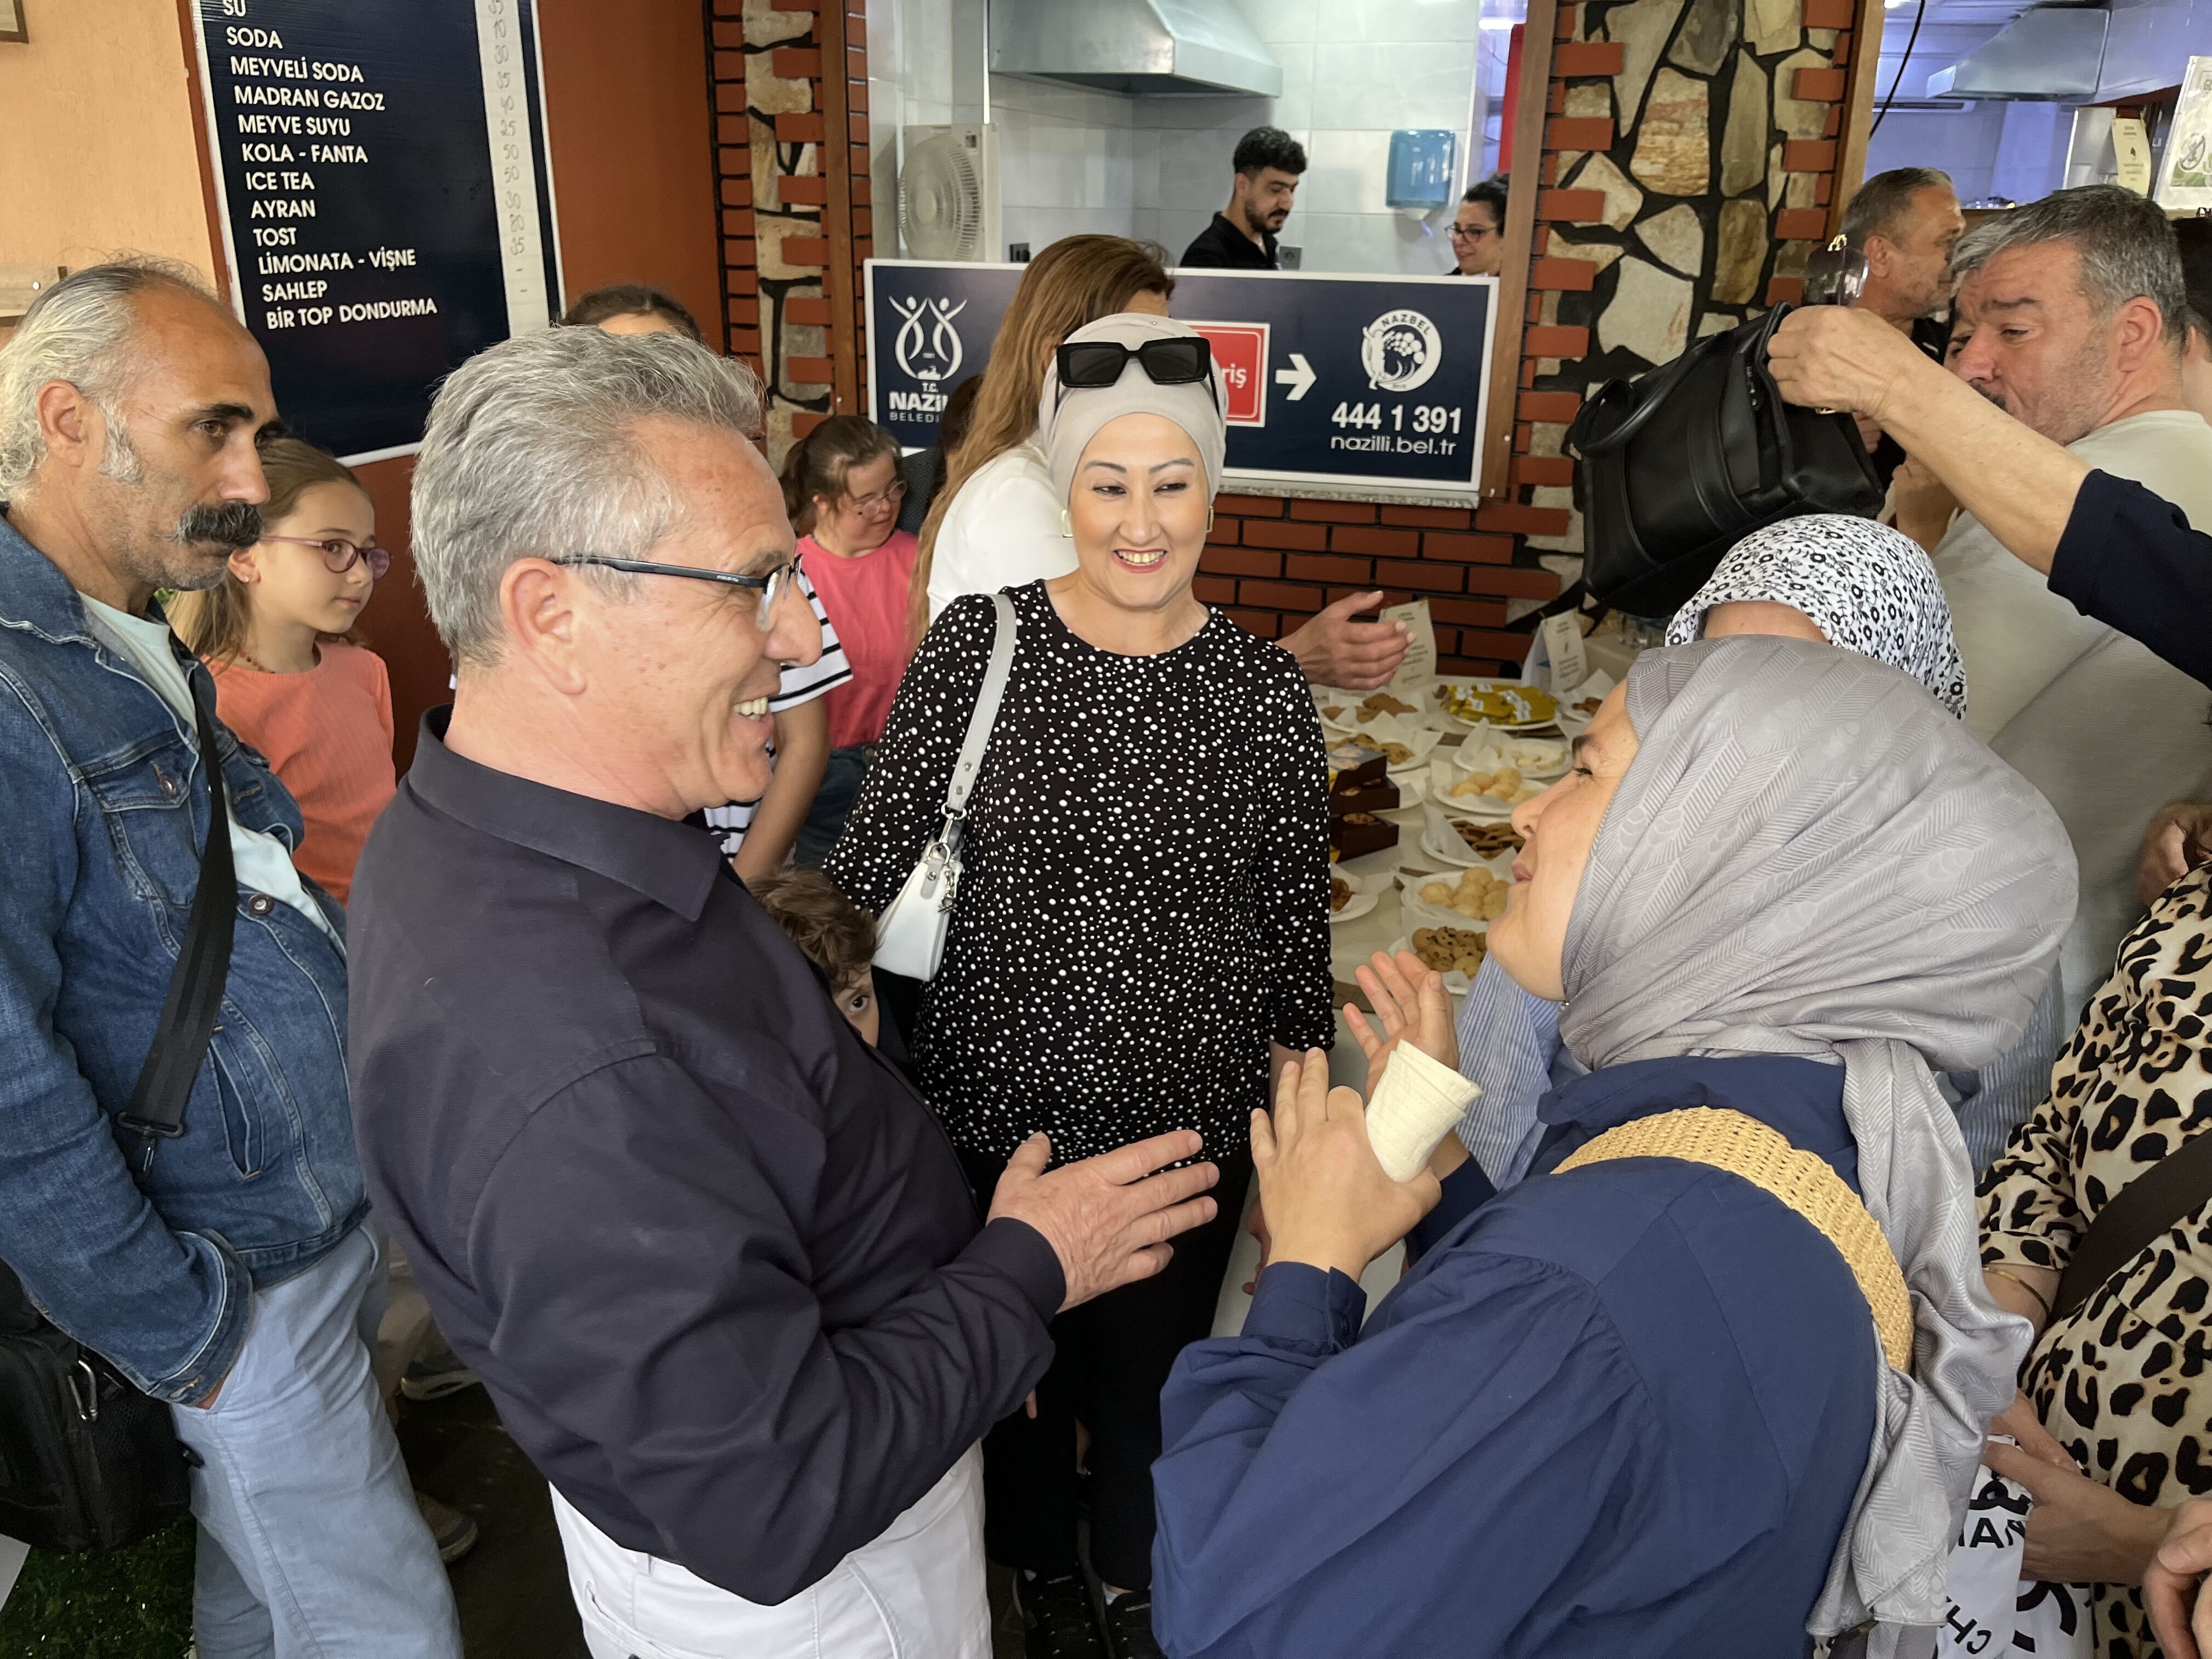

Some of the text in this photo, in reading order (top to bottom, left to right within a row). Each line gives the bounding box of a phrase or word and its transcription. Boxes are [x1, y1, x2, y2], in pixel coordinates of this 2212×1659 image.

[223, 0, 246, 17] SU
[226, 26, 283, 49] SODA
[230, 55, 364, 83] MEYVELİ SODA
[234, 85, 386, 111] MADRAN GAZOZ
[238, 114, 351, 136] MEYVE SUYU
[241, 143, 295, 162] KOLA
[311, 144, 368, 163] FANTA
[503, 143, 520, 160] 50
[245, 172, 315, 190] ICE TEA
[251, 199, 316, 219] AYRAN
[252, 227, 297, 247] TOST
[258, 251, 354, 274] LİMONATA
[368, 246, 416, 272] VİŞNE
[262, 280, 328, 302] SAHLEP
[266, 297, 438, 329] BİR TOP DONDURMA
[1381, 314, 1431, 335] NAZBEL
[922, 382, 939, 393] T.C.
[1331, 402, 1462, 434] 444 1 391
[1330, 435, 1457, 456] nazilli.bel.tr
